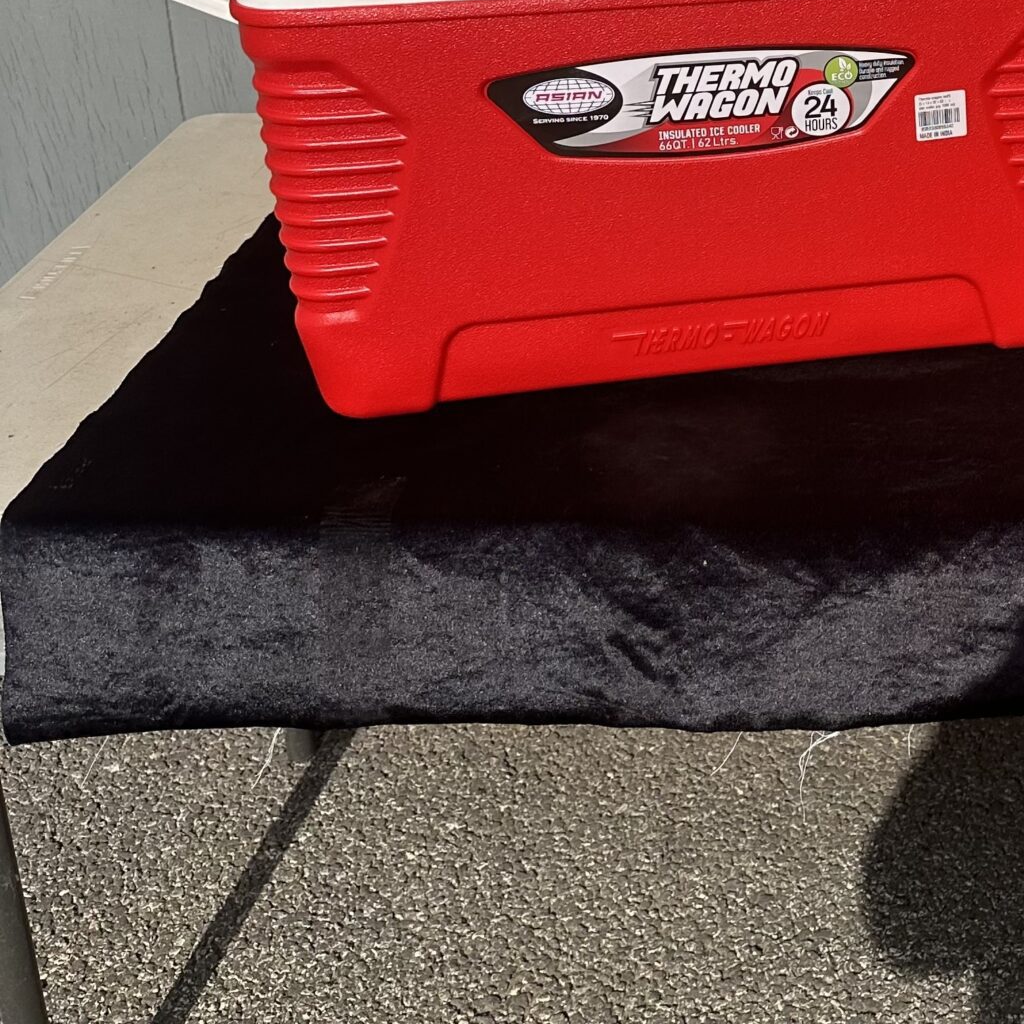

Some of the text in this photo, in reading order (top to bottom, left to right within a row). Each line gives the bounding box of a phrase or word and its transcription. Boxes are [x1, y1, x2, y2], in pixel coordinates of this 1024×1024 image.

[656, 59, 798, 95] THERMO
[831, 71, 853, 82] ECO
[535, 90, 604, 103] ASIAN
[650, 87, 789, 123] WAGON
[804, 94, 838, 119] 24
[533, 117, 565, 125] SERVING
[805, 117, 838, 132] HOURS
[658, 124, 760, 141] INSULATED ICE COOLER
[659, 136, 739, 151] 66QT. 62 Ltrs.
